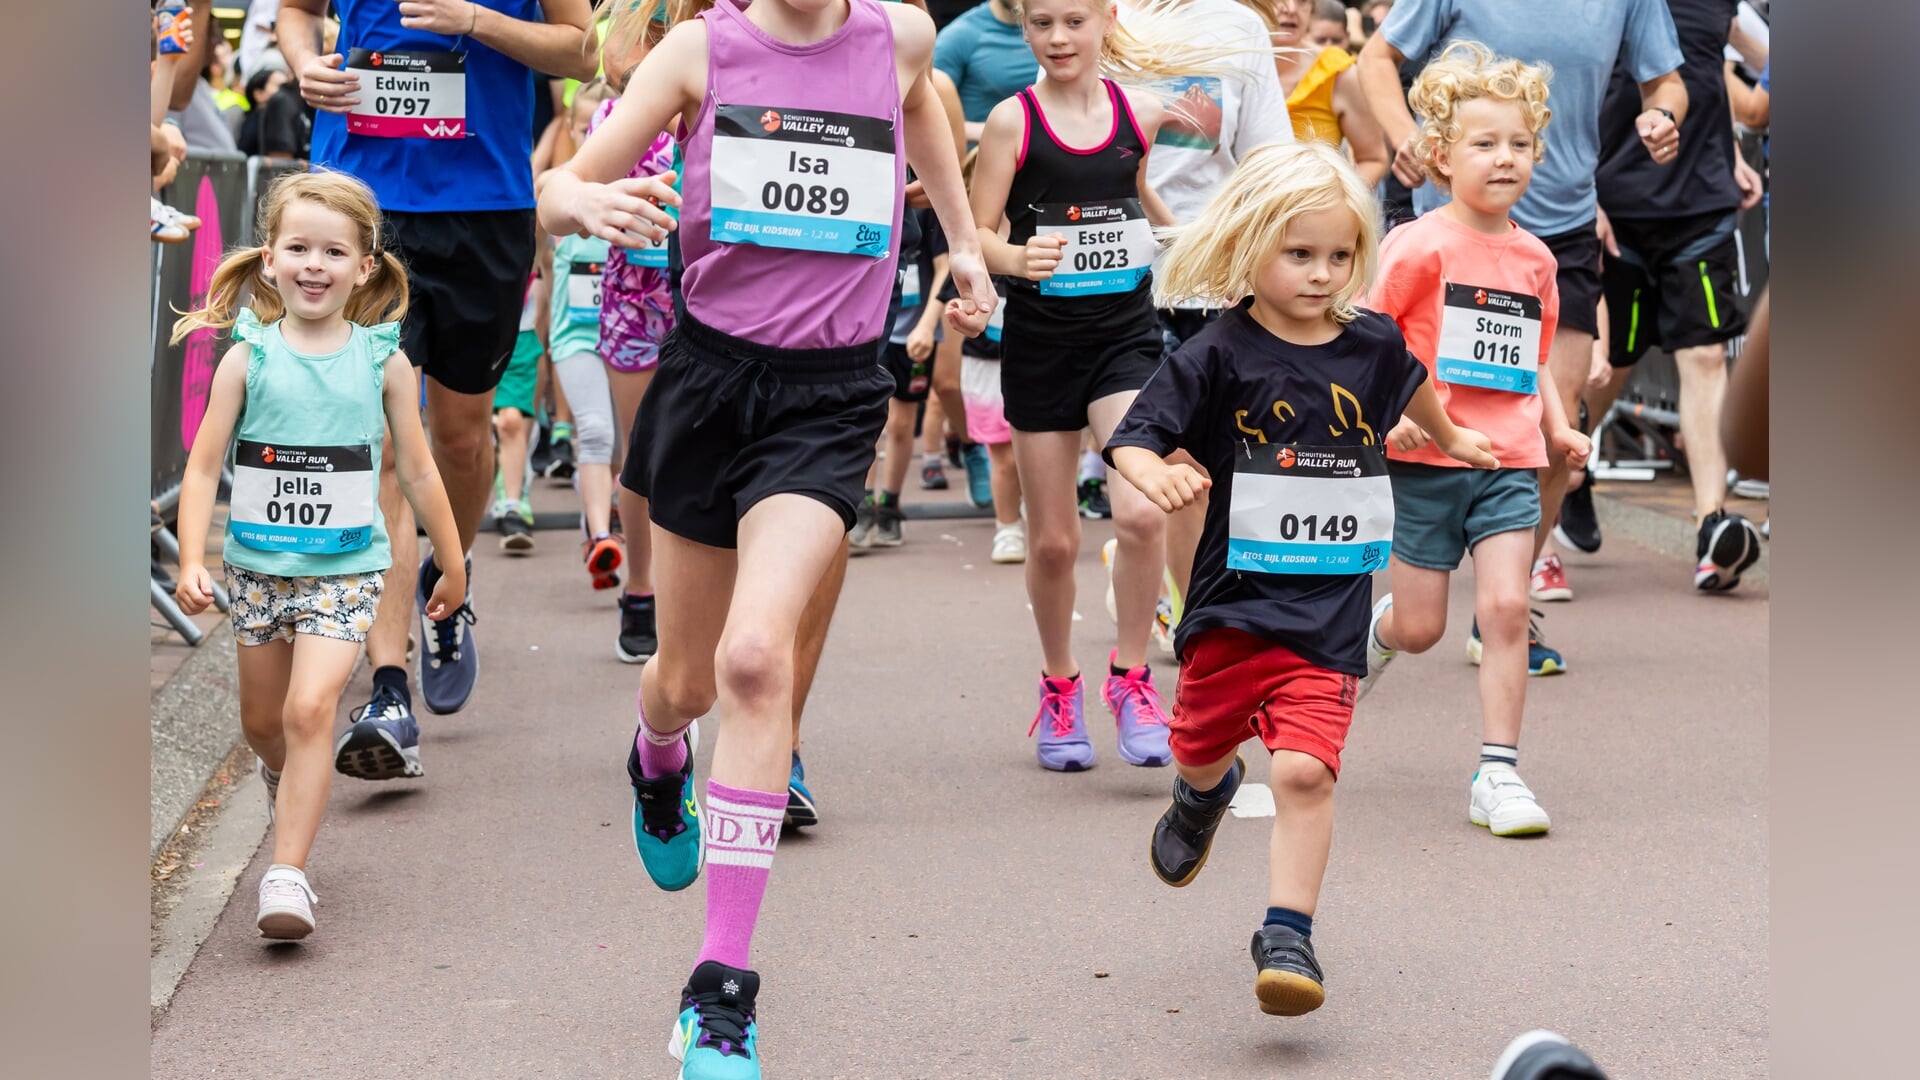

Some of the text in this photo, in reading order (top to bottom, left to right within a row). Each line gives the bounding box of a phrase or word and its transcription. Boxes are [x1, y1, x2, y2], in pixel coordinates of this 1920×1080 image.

[376, 76, 430, 92] Edwin
[375, 97, 431, 116] 0797
[783, 114, 824, 123] SCHUITEMAN
[782, 120, 850, 136] VALLEY RUN
[789, 151, 829, 175] Isa
[762, 181, 849, 216] 0089
[1082, 209, 1108, 218] VALLEY
[724, 220, 743, 230] ETOS
[744, 222, 760, 234] BIJL
[762, 224, 802, 237] KIDSRUN
[811, 229, 823, 239] 1,2
[825, 231, 839, 240] KM
[856, 224, 881, 241] Etos
[1078, 230, 1124, 245] Ester
[1074, 248, 1129, 272] 0023
[1487, 298, 1523, 309] VALLEY RUN
[1476, 317, 1522, 339] Storm
[1473, 340, 1520, 365] 0116
[276, 454, 328, 464] VALLEY RUN
[1297, 451, 1335, 459] SCHUITEMAN
[1297, 457, 1357, 468] VALLEY RUN
[273, 477, 322, 498] Jella
[266, 501, 332, 526] 0107
[339, 529, 361, 542] Etos
[1279, 513, 1358, 542] 0149
[241, 531, 255, 539] ETOS
[256, 533, 267, 542] BIJL
[269, 534, 298, 543] KIDSRUN
[1242, 551, 1262, 561] ETOS
[1264, 552, 1279, 563] BIJL
[1281, 553, 1318, 564] KIDSRUN
[1326, 555, 1337, 564] 1,2
[1362, 545, 1380, 561] Etos
